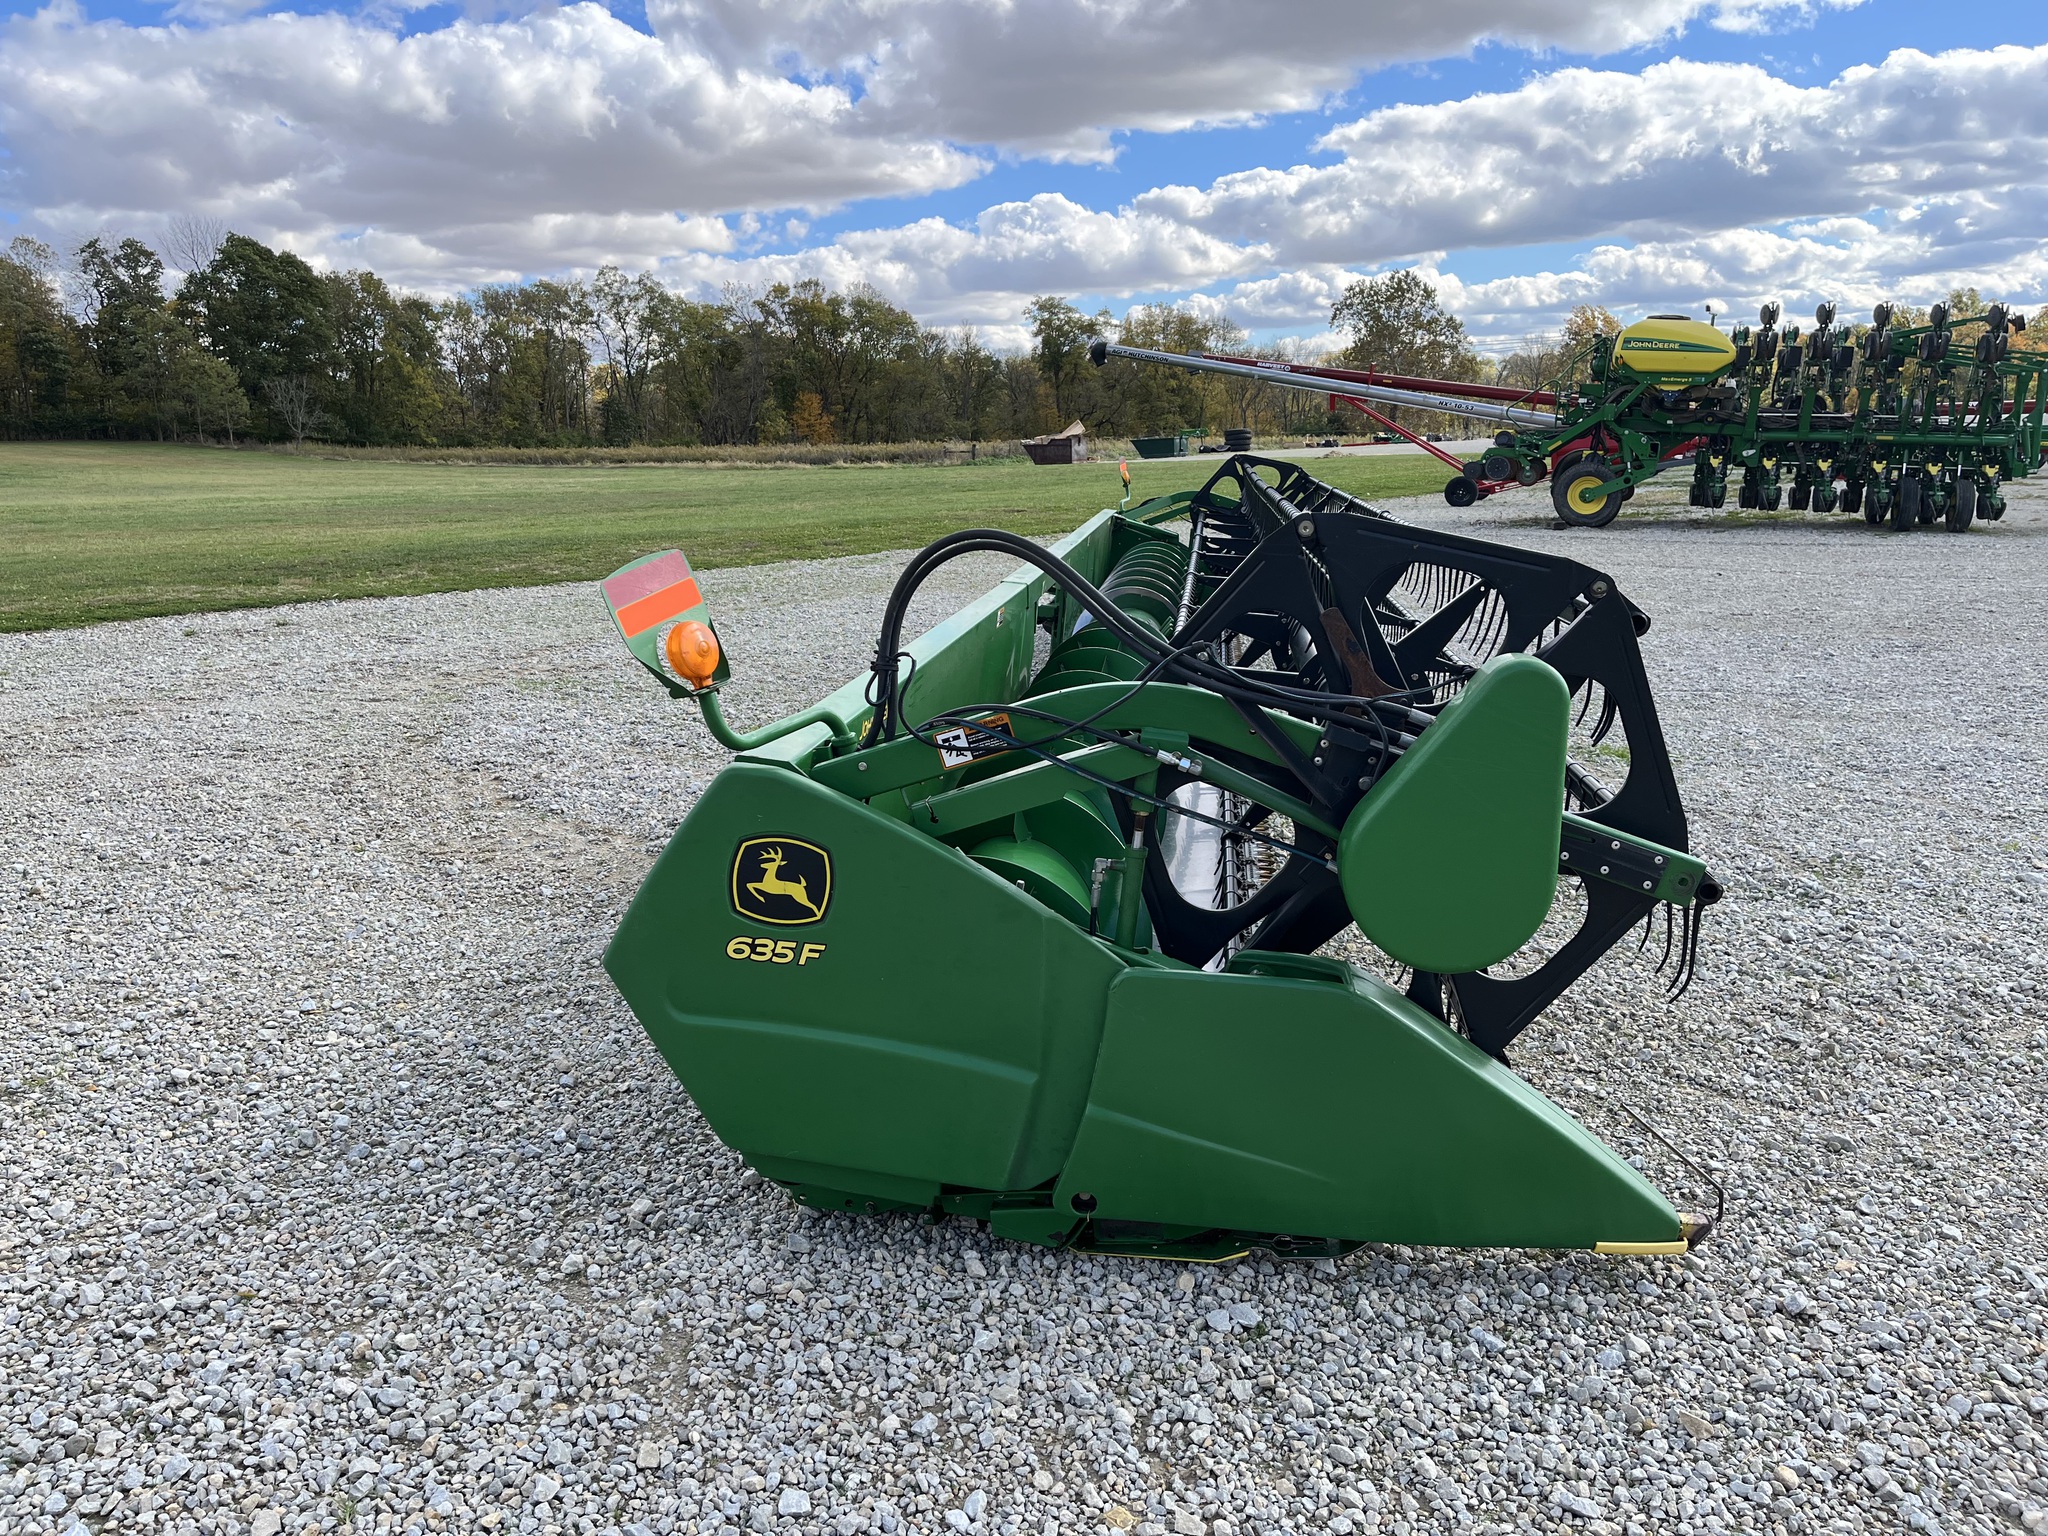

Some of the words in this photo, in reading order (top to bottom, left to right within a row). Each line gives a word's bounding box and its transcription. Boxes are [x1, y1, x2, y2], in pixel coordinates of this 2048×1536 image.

[1628, 340, 1652, 348] JOHN
[1652, 341, 1680, 349] DEERE
[1128, 351, 1170, 363] HUTCHINSON
[1257, 361, 1286, 369] HARVEST
[1454, 403, 1475, 411] 10-53
